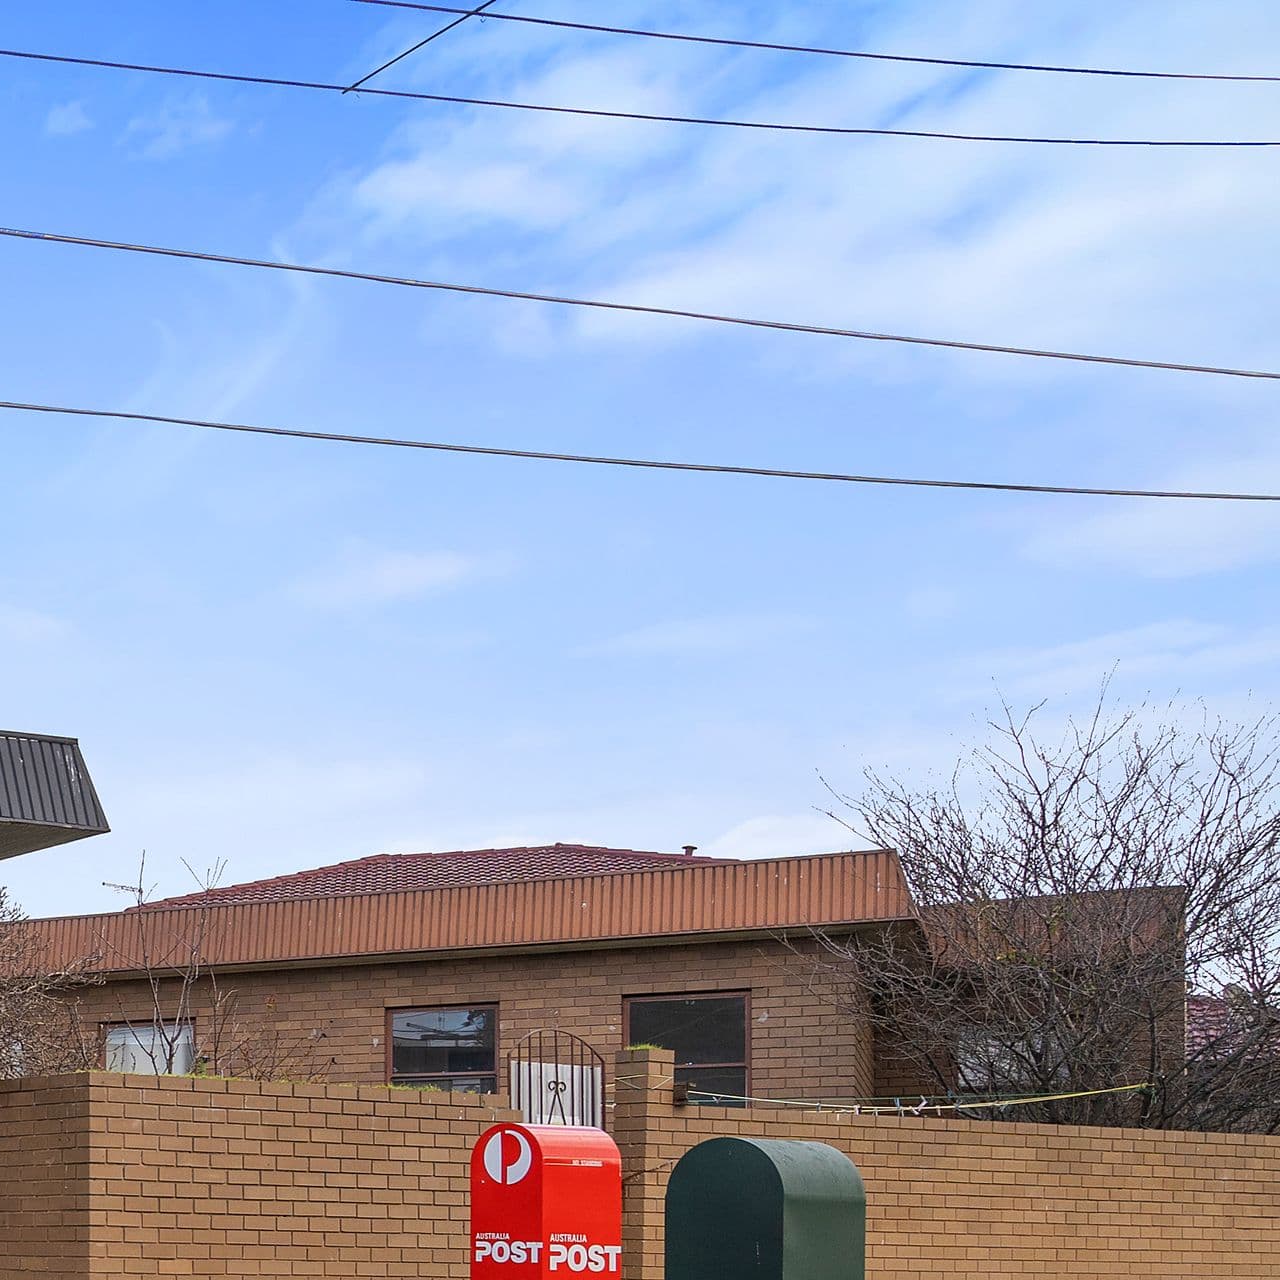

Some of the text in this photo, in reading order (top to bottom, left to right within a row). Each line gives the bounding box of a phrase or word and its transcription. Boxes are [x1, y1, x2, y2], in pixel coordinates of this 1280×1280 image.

[475, 1232, 510, 1240] AUSTRALIA
[550, 1233, 587, 1243] AUSTRALIA
[475, 1241, 543, 1263] POST
[549, 1244, 622, 1272] POST
